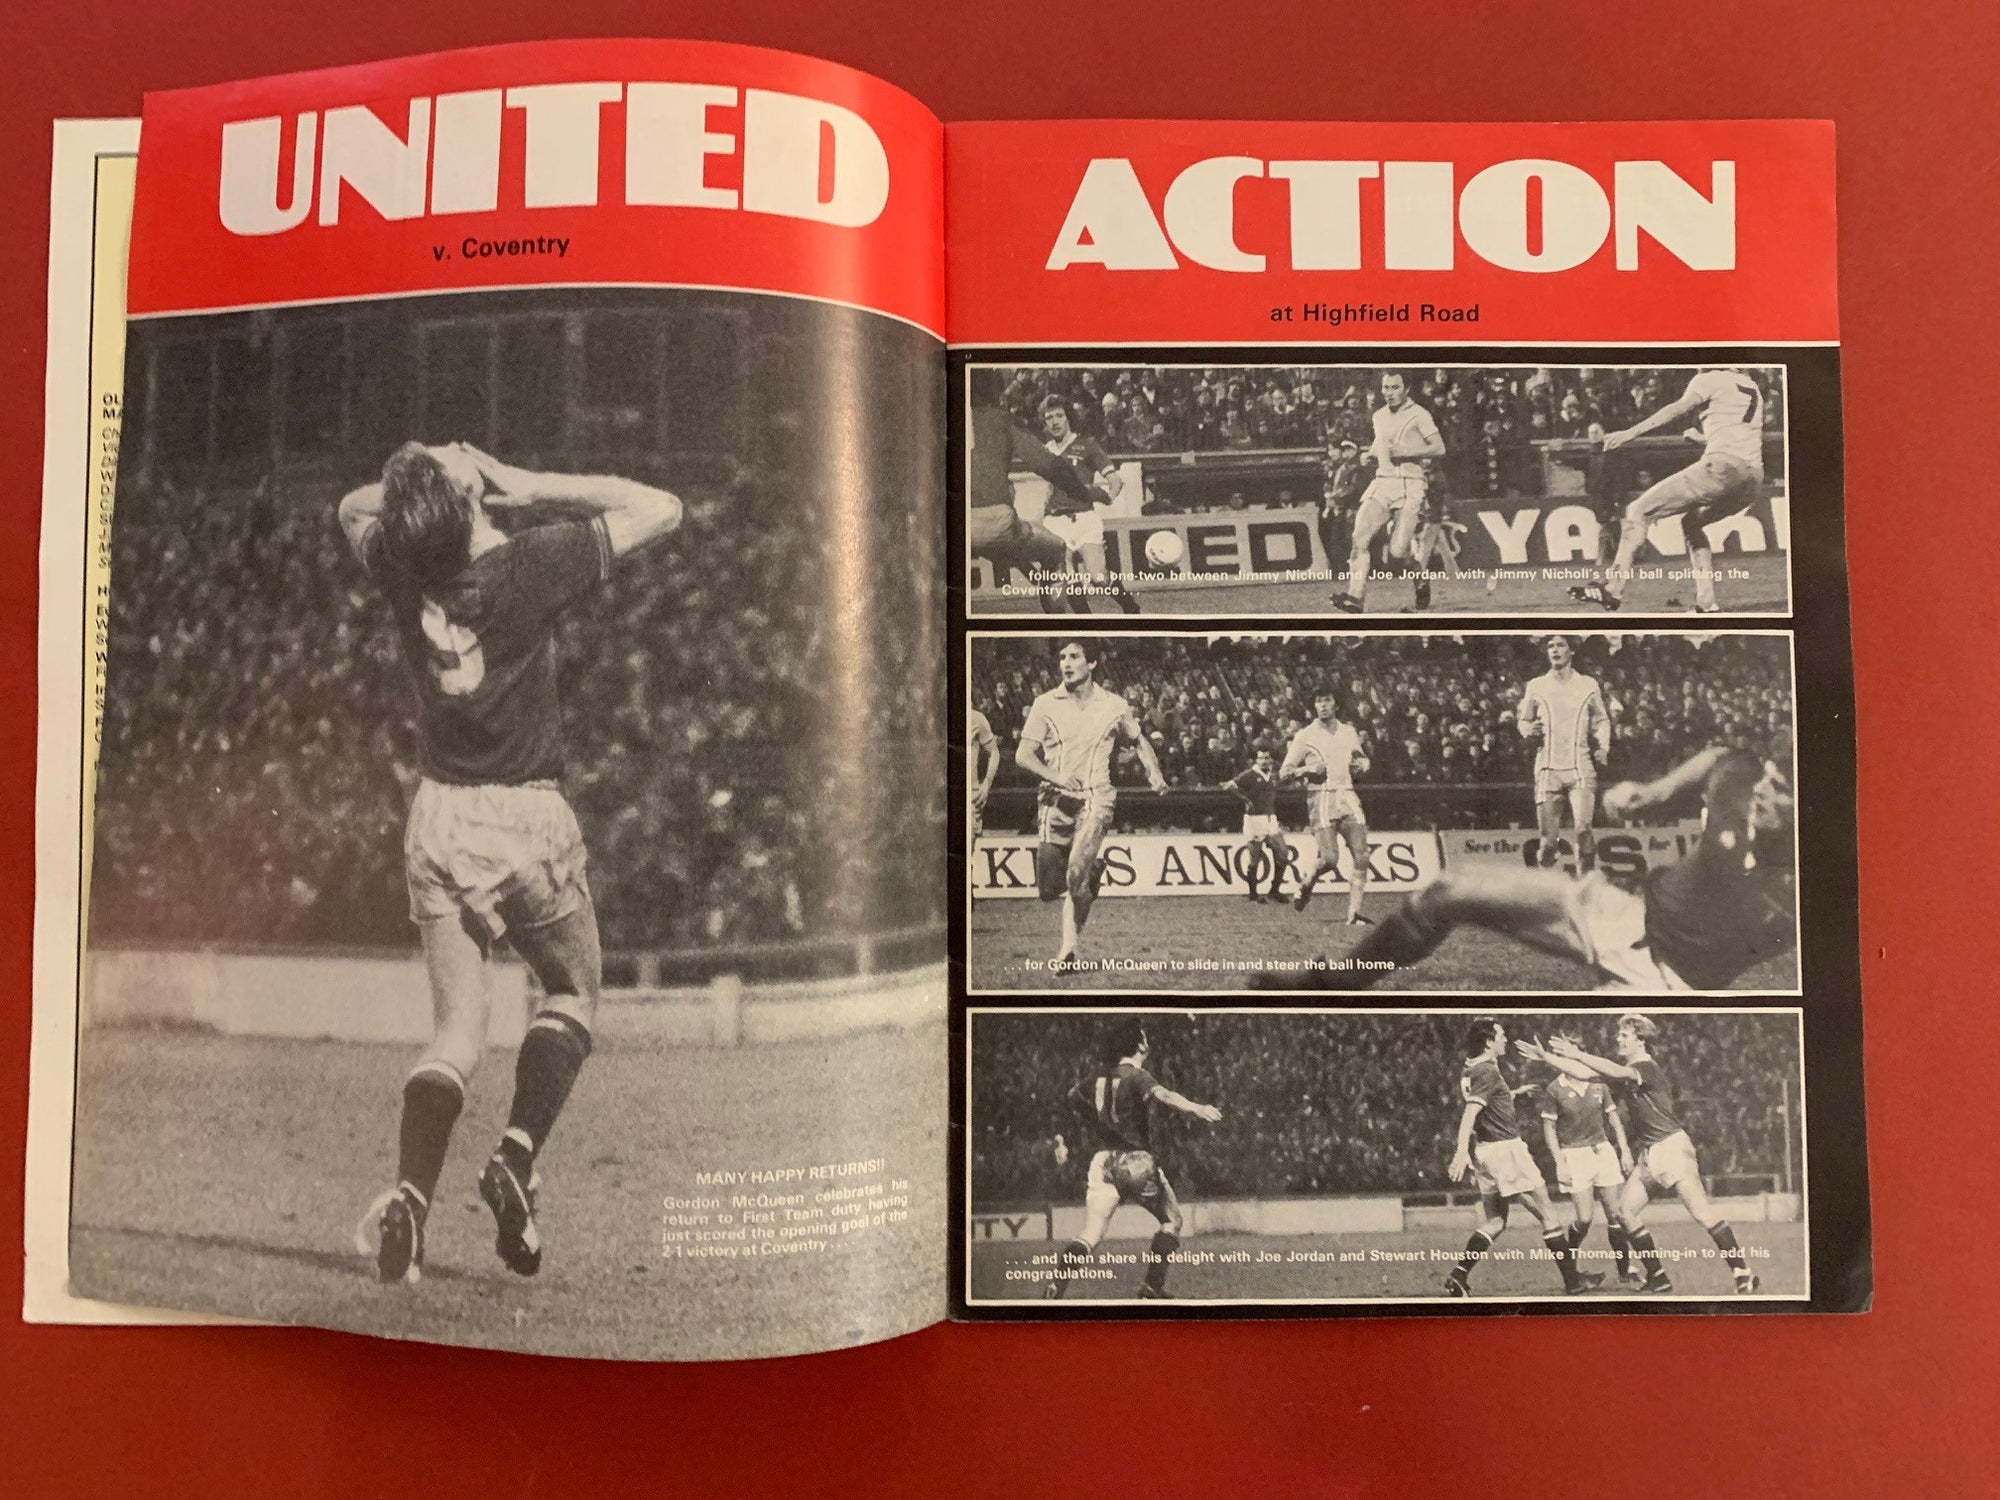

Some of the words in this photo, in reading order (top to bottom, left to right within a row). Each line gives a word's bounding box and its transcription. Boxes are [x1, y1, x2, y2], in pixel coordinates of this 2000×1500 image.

[219, 81, 890, 237] UNITED
[1045, 155, 1736, 273] ACTION
[432, 245, 451, 262] v.
[462, 235, 570, 258] Coventry
[1270, 305, 1293, 322] at
[1303, 303, 1409, 326] Highfield
[1420, 303, 1479, 322] Road
[1736, 382, 1758, 424] 7
[1028, 570, 1091, 583] following
[1109, 570, 1164, 582] one-two
[1170, 570, 1229, 582] between
[1234, 569, 1280, 583] Jimmy
[1286, 569, 1333, 581] Nicholl
[1338, 569, 1362, 581] and
[1368, 568, 1394, 581] Joe
[1399, 568, 1449, 582] Jordan,
[1455, 568, 1486, 581] with
[1491, 568, 1537, 583] Jimmy
[1543, 567, 1600, 581] Nicholl's
[1605, 568, 1635, 581] final
[1640, 567, 1663, 580] ball
[1728, 567, 1750, 580] the
[1001, 583, 1063, 599] Coventry
[1066, 583, 1120, 597] defence
[1025, 958, 1043, 971] for
[1048, 958, 1098, 971] Gordon
[1101, 958, 1168, 971] McQueen
[1171, 958, 1185, 971] to
[1188, 958, 1219, 971] slide
[1222, 958, 1235, 970] in
[1238, 958, 1263, 970] and
[1266, 958, 1300, 970] steer
[1304, 958, 1326, 970] the
[1329, 958, 1353, 970] ball
[1357, 958, 1395, 970] home
[695, 1171, 747, 1185] MANY
[751, 1168, 806, 1183] HAPPY
[809, 1158, 885, 1179] RETURNS!!
[663, 1196, 720, 1210] Gordon
[732, 1192, 804, 1209] McQueen
[815, 1182, 883, 1203] celebrates
[891, 1178, 908, 1191] his
[663, 1213, 709, 1226] return
[718, 1213, 733, 1224] to
[743, 1210, 775, 1224] First
[784, 1208, 824, 1221] Team
[831, 1202, 862, 1217] duty
[868, 1195, 908, 1211] having
[662, 1229, 691, 1244] just
[695, 1227, 746, 1241] scored
[751, 1226, 775, 1239] the
[780, 1221, 837, 1240] opening
[841, 1214, 869, 1234] goal
[873, 1210, 887, 1225] of
[889, 1208, 908, 1222] the
[686, 1244, 739, 1260] victory
[742, 1243, 758, 1256] at
[760, 1239, 828, 1257] Coventry
[1032, 1253, 1058, 1265] and
[1063, 1252, 1094, 1264] then
[1099, 1252, 1137, 1264] share
[1142, 1252, 1162, 1264] his
[1169, 1250, 1215, 1265] delight
[1220, 1250, 1251, 1263] with
[1256, 1250, 1281, 1263] Joe
[1287, 1250, 1335, 1262] Jordan
[1340, 1249, 1365, 1262] and
[1370, 1249, 1426, 1262] Stewart
[1430, 1249, 1488, 1261] Houston
[1494, 1248, 1525, 1261] with
[1530, 1248, 1565, 1260] Mike
[1568, 1247, 1624, 1261] Thomas
[1628, 1247, 1697, 1262] running-in
[1702, 1247, 1716, 1259] to
[1720, 1247, 1745, 1259] add
[1750, 1247, 1771, 1259] his
[1005, 1267, 1118, 1283] congratulations.
